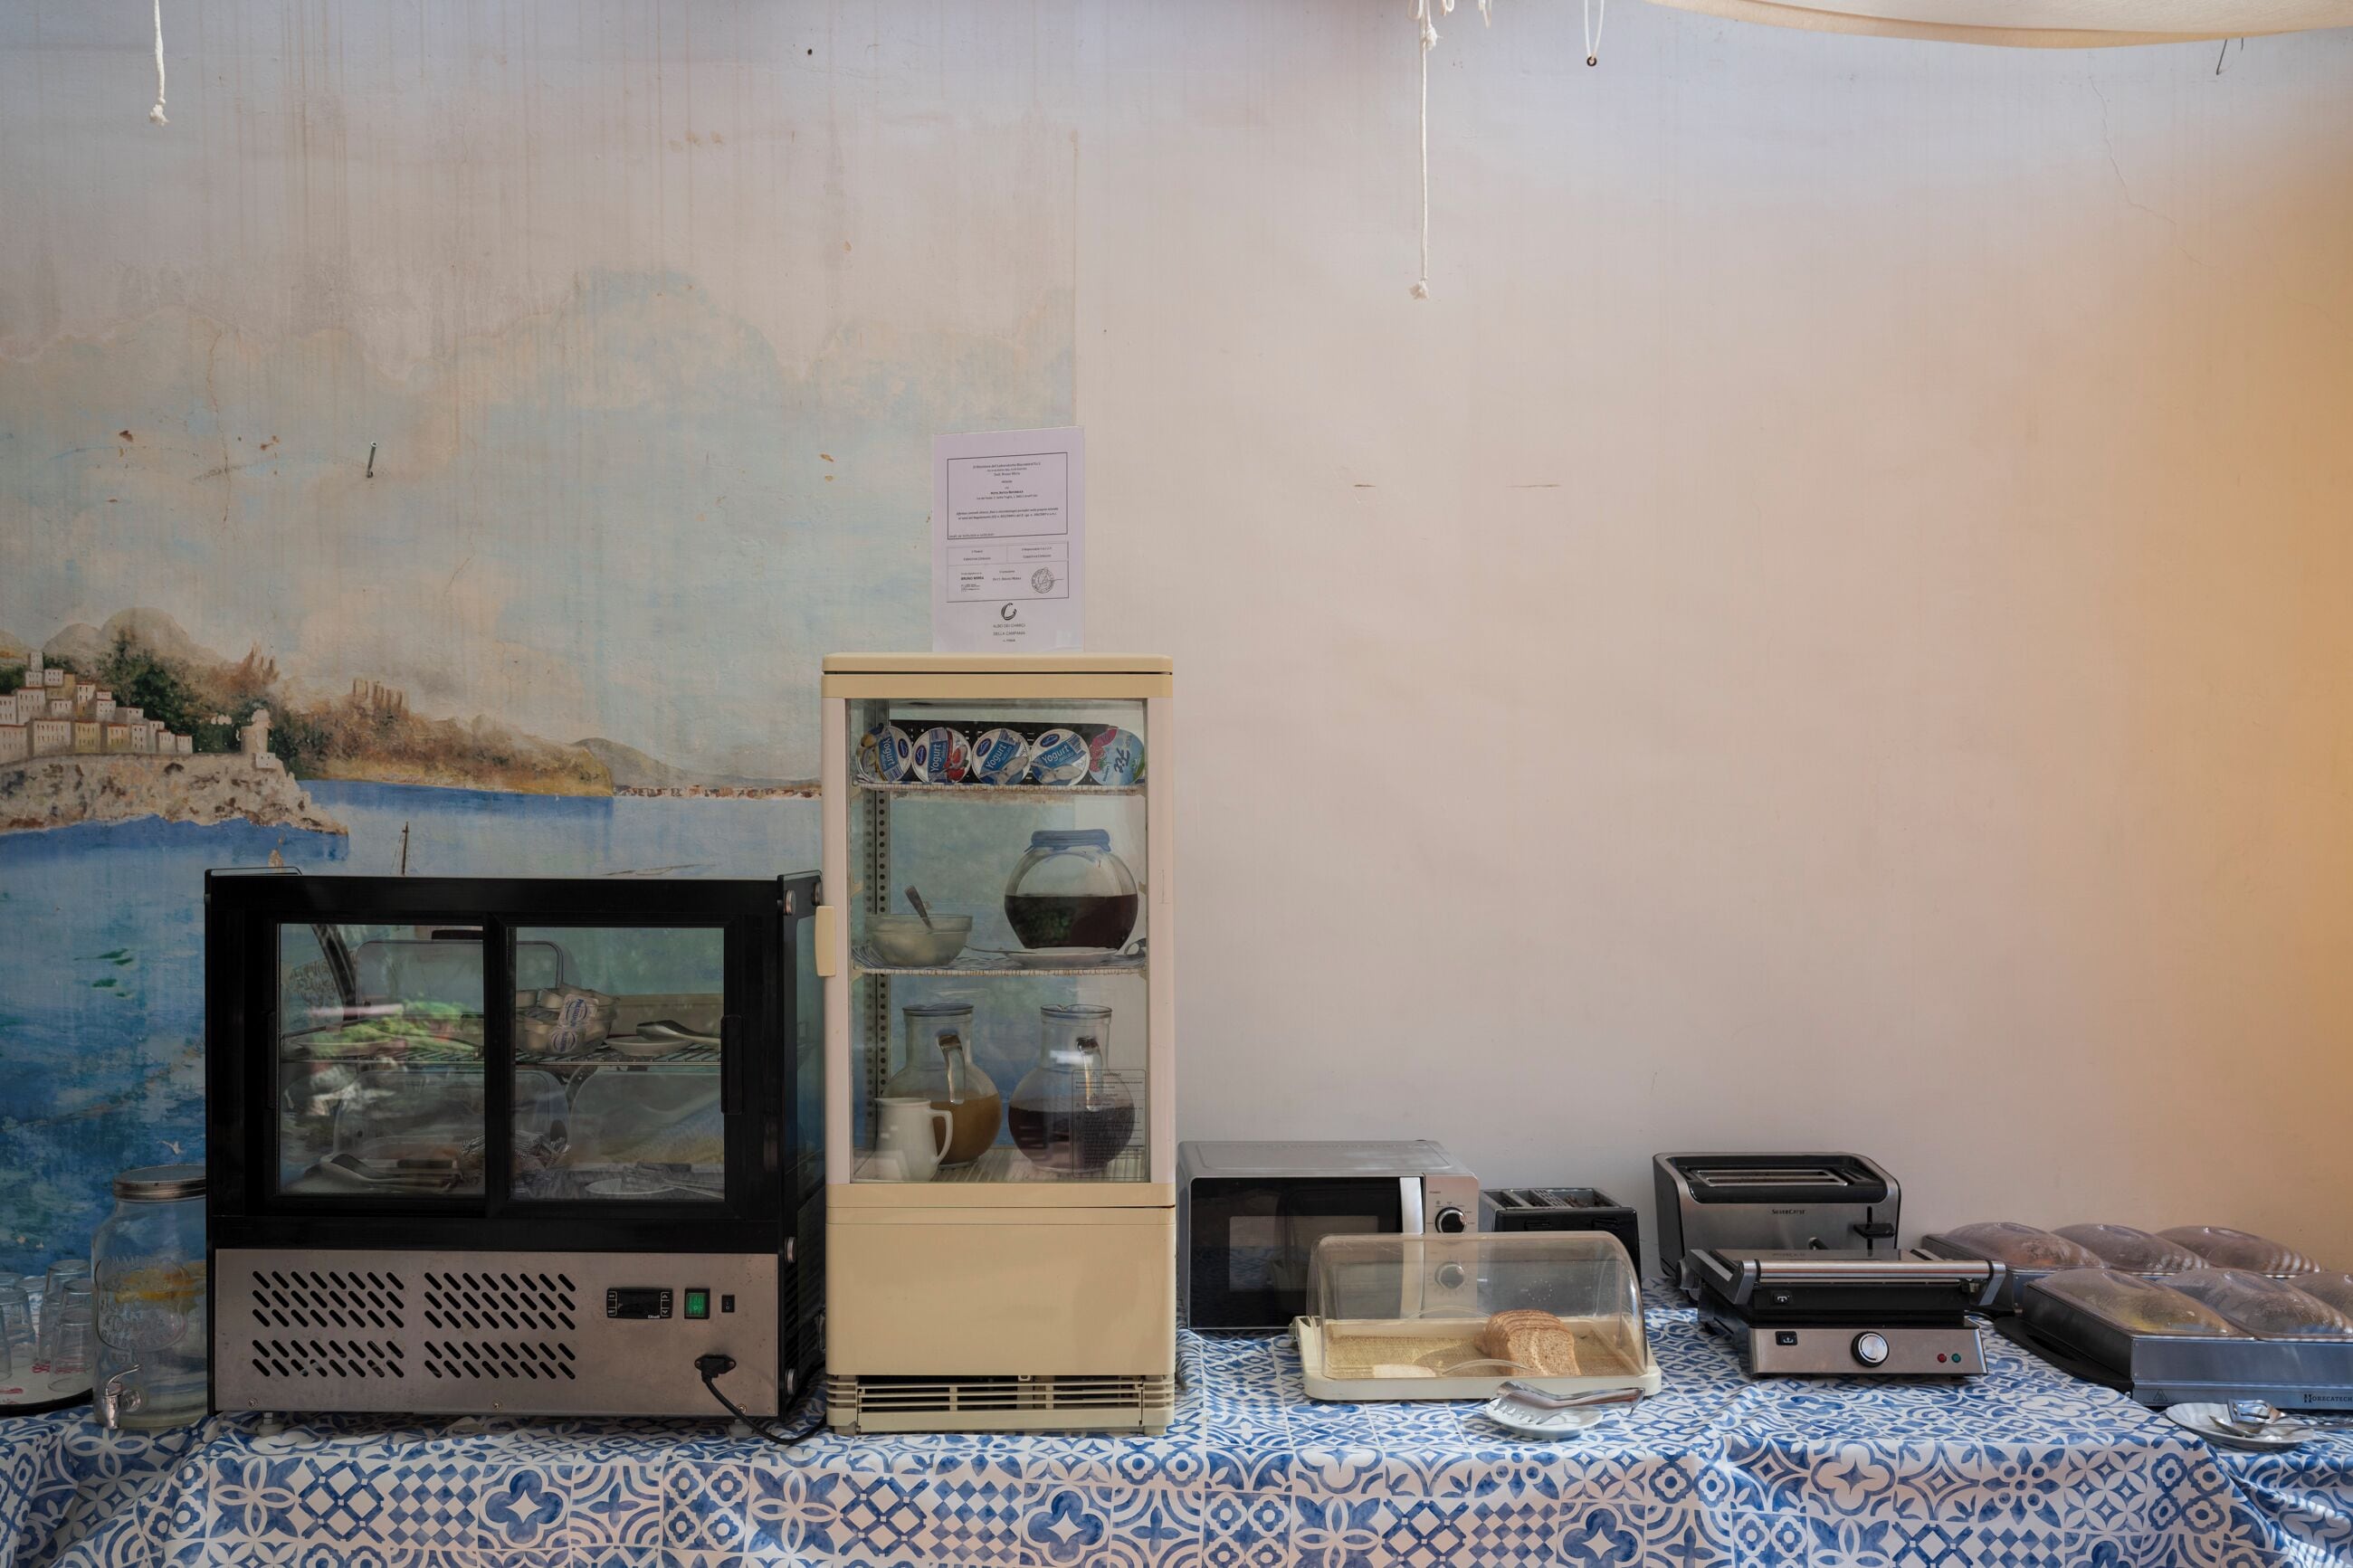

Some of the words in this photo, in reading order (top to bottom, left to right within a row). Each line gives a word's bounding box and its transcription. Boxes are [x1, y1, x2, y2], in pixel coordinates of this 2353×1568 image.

[883, 738, 896, 766] Yogurt
[929, 744, 941, 773] Yogurt
[986, 744, 1007, 769] Yogurt
[1042, 745, 1070, 764] Yogurt
[2303, 1393, 2353, 1402] HORECATECH
